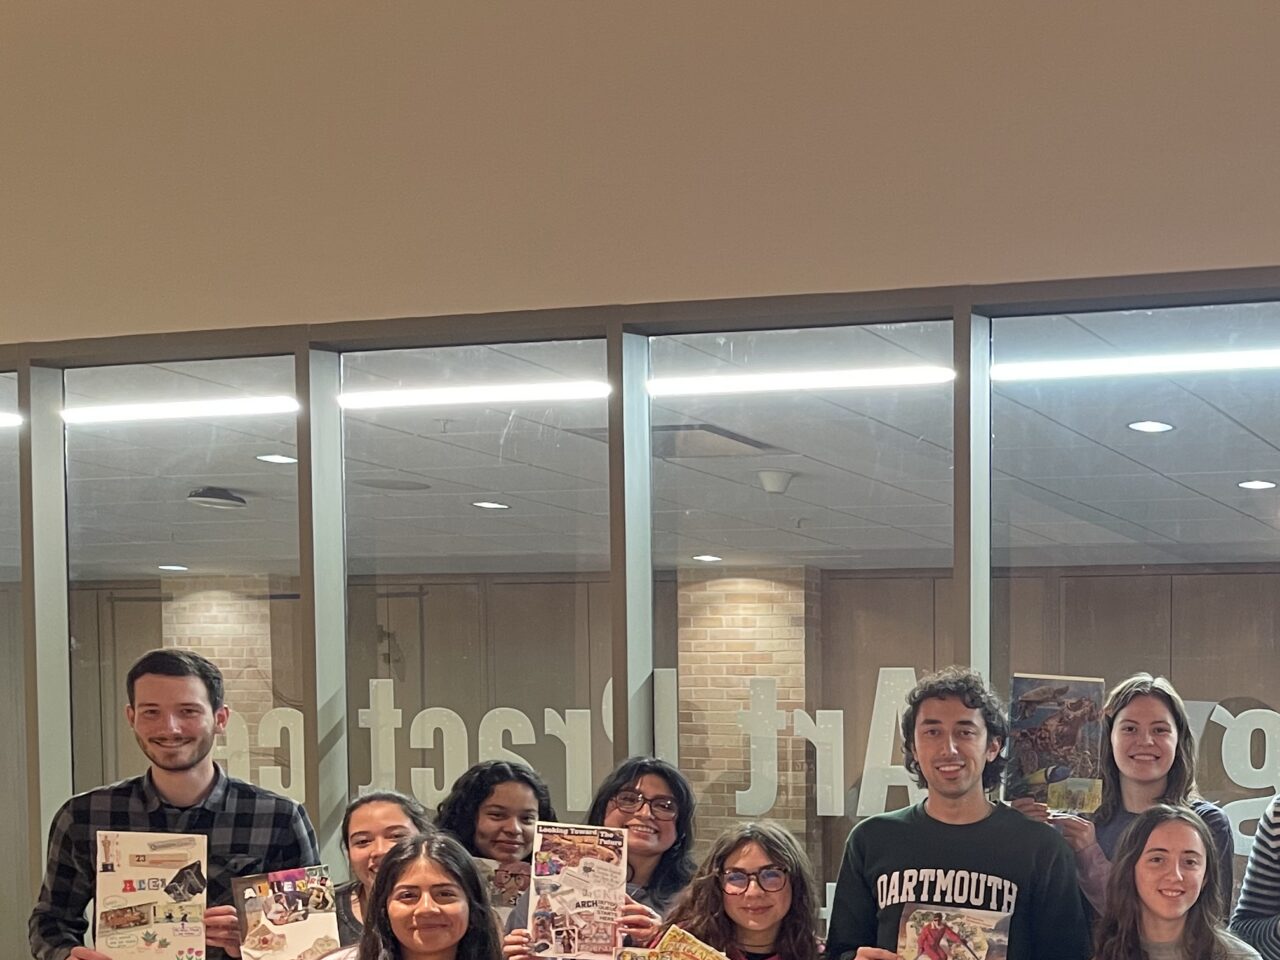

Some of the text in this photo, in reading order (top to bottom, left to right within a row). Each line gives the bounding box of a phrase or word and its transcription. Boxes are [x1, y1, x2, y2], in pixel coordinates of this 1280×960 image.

[538, 826, 568, 834] Looking
[600, 838, 622, 846] Future
[877, 869, 1018, 914] DARTMOUTH
[576, 900, 598, 908] ARCH
